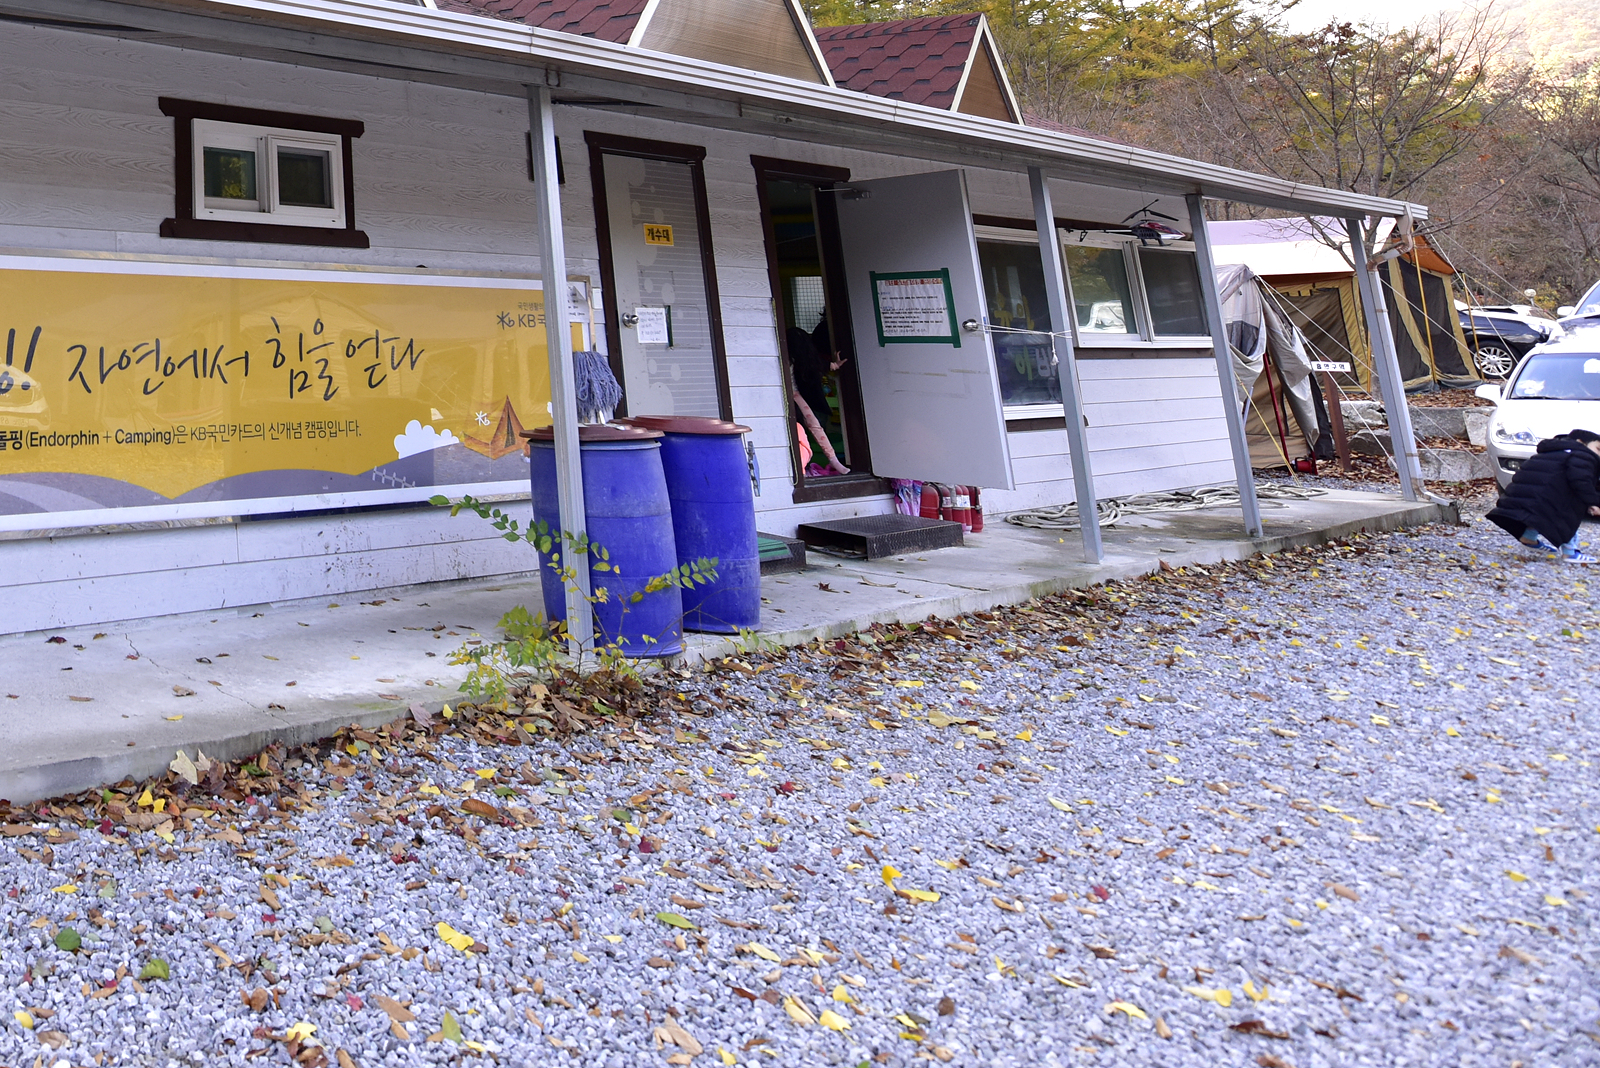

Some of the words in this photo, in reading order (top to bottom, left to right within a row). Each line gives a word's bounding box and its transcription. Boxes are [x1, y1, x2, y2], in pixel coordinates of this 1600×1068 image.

[646, 228, 671, 242] 개수대
[66, 337, 249, 394] 자연에서
[265, 315, 337, 401] 힘을
[345, 328, 426, 390] 얻다
[114, 425, 189, 446] Camping)은
[190, 422, 266, 444] KB국민카드의
[268, 420, 303, 441] 신개념
[304, 419, 363, 440] 캠핑입니다.
